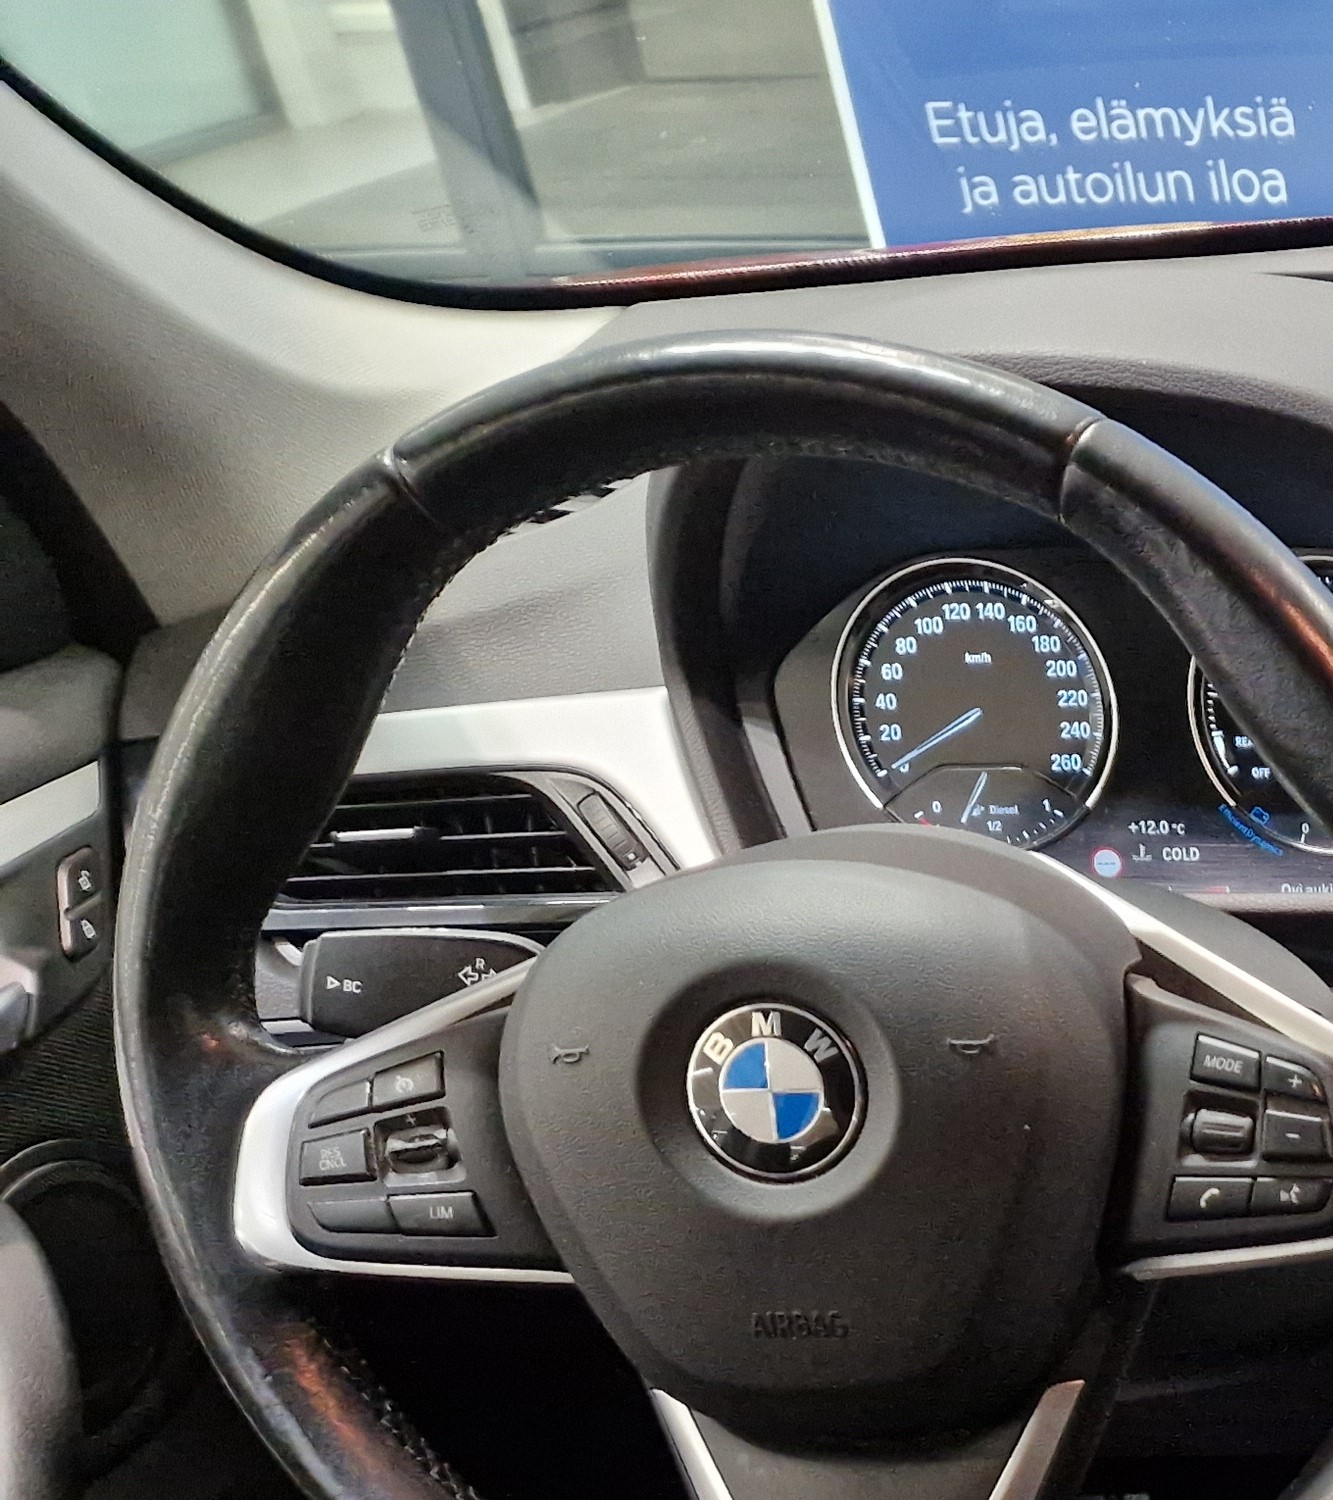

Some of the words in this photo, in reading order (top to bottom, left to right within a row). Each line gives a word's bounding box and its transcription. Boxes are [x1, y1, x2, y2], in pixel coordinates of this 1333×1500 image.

[924, 99, 1059, 151] Etuja,
[1069, 95, 1296, 147] elämyksiä
[956, 165, 999, 214] ja
[1010, 160, 1195, 206] autoilun
[1205, 158, 1288, 205] iloa
[942, 603, 971, 620] 120
[975, 602, 1006, 620] 140
[914, 617, 944, 634] 100
[1008, 615, 1037, 633] 160
[895, 637, 918, 654] 80
[1031, 636, 1061, 653] 180
[964, 652, 992, 664] km/h
[881, 663, 903, 681] 60
[1046, 660, 1077, 677] 200
[875, 693, 897, 710] 40
[1057, 690, 1088, 706] 220
[880, 724, 901, 741] 20
[1059, 722, 1091, 739] 240
[1234, 736, 1254, 748] REA
[1051, 754, 1081, 771] 260
[1251, 768, 1271, 779] OFF
[931, 801, 942, 813] 0
[989, 804, 1020, 815] Diesel
[986, 820, 1003, 832] 1/2
[1162, 847, 1200, 862] COLD
[342, 978, 363, 994] BC
[702, 1011, 840, 1066] BMW
[1203, 1054, 1243, 1074] MODE
[429, 1206, 454, 1219] LIM
